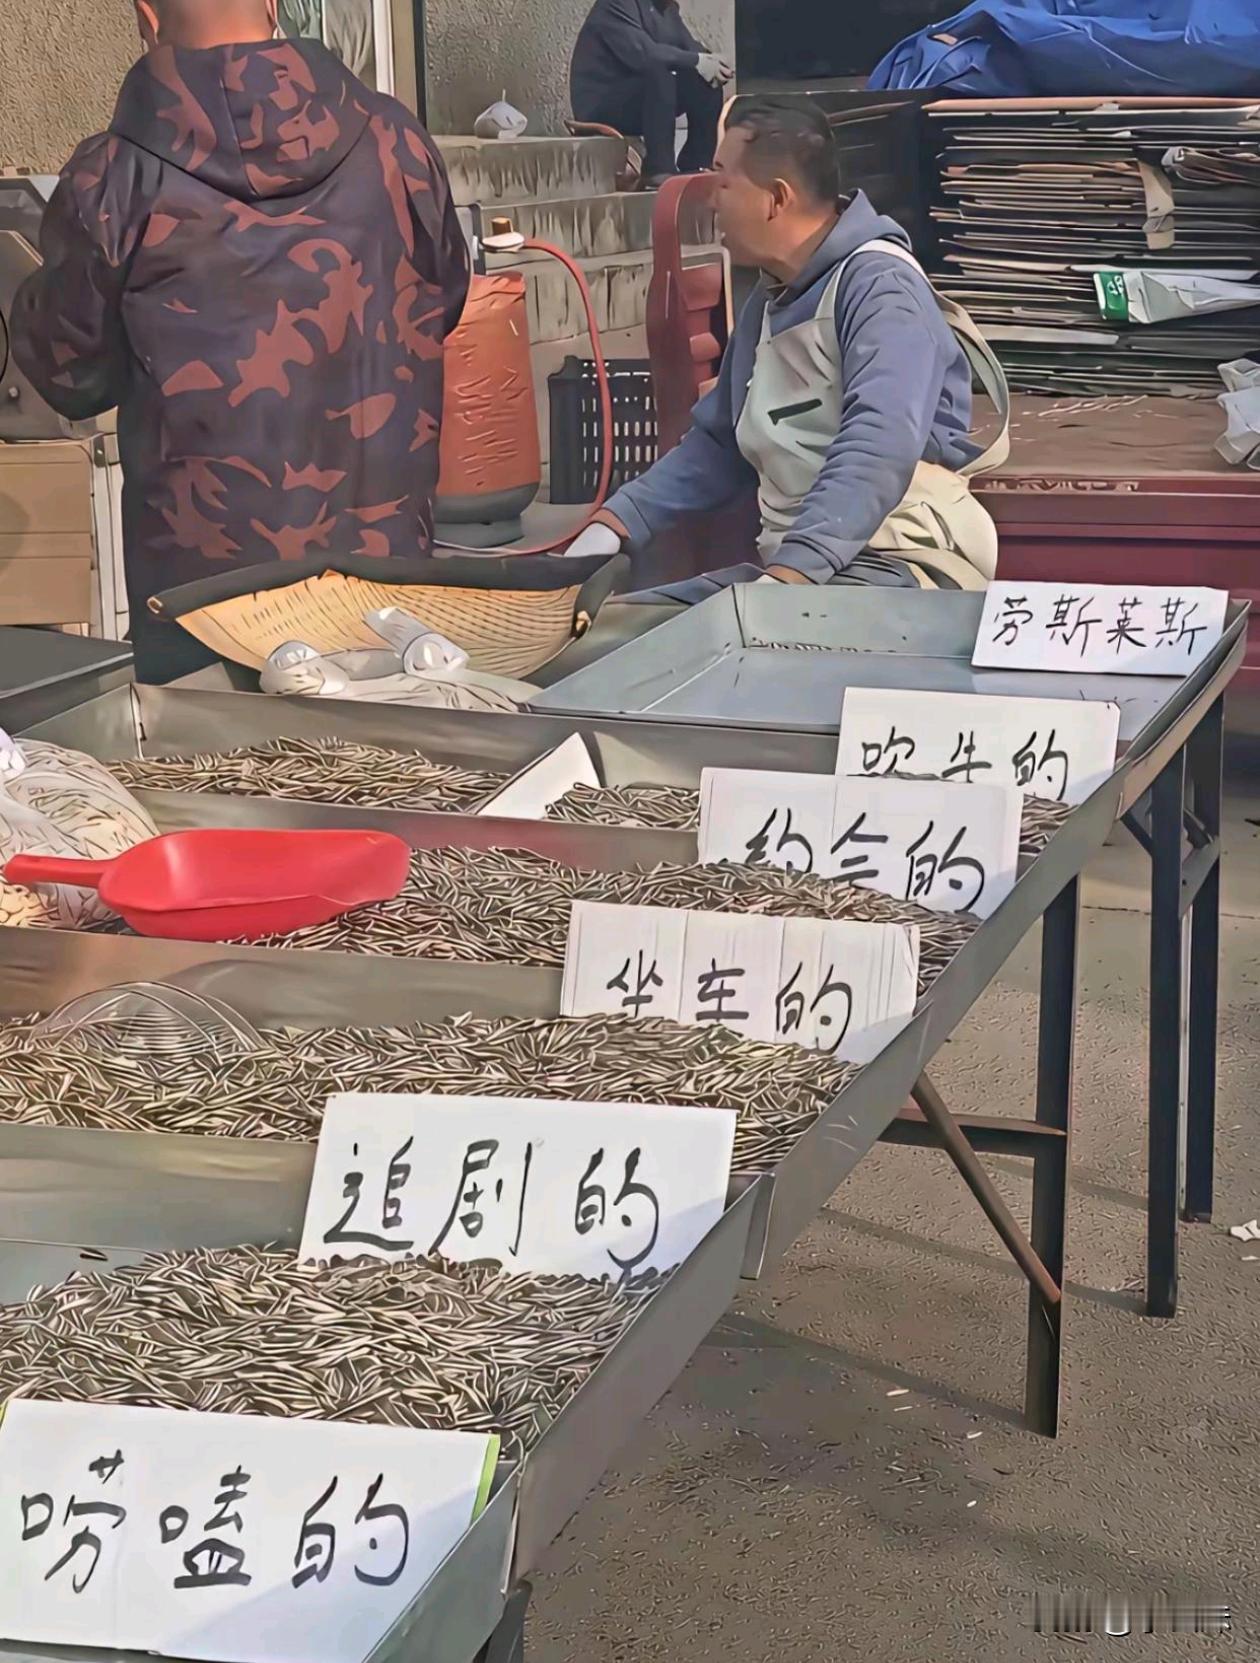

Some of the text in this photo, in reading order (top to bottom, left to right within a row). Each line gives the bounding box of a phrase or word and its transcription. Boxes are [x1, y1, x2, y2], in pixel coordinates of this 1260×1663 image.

[992, 595, 1209, 657] 劳斯莱斯
[861, 726, 1069, 802] 吹牛的
[744, 808, 986, 912] 约会的
[606, 950, 853, 1056] 坐车的
[323, 1136, 660, 1269] 追剧的
[20, 1449, 409, 1594] 唠嗑的
